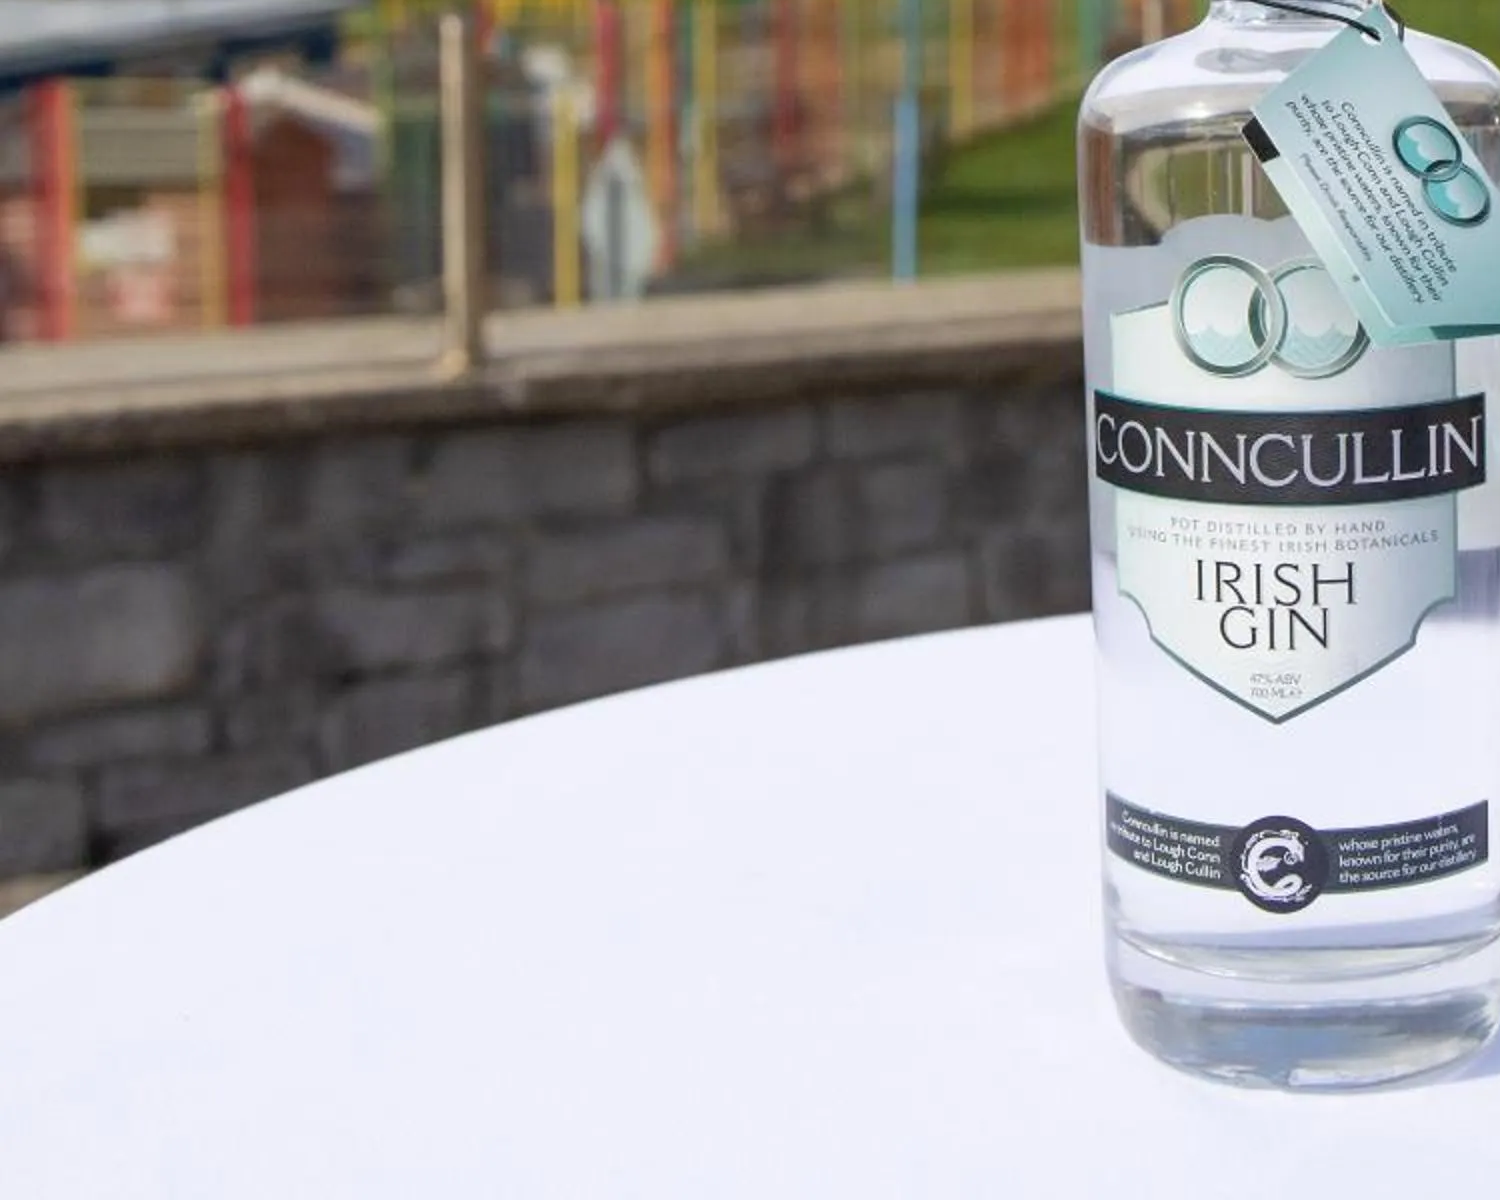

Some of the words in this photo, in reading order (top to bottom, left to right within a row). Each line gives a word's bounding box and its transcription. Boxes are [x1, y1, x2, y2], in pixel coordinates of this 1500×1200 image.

[1300, 94, 1328, 129] whose
[1323, 130, 1356, 171] pristine
[1381, 214, 1411, 255] known
[1408, 254, 1422, 271] for
[1418, 273, 1441, 301] their
[1330, 112, 1360, 151] Lough
[1356, 150, 1382, 185] Conn
[1378, 186, 1401, 209] and
[1394, 208, 1424, 248] Lough
[1420, 248, 1448, 286] Cullin
[1340, 101, 1385, 164] Conncullin
[1390, 176, 1423, 217] named
[1426, 230, 1456, 271] tribute
[1325, 156, 1342, 176] the
[1339, 177, 1367, 213] source
[1363, 214, 1378, 230] for
[1374, 232, 1392, 251] our
[1389, 254, 1424, 303] distillery
[1097, 413, 1482, 487] CONNCULLIN
[1171, 516, 1200, 531] POT
[1206, 519, 1297, 536] DISTILLED
[1304, 522, 1327, 536] BY
[1335, 519, 1386, 535] HAND
[1171, 533, 1202, 549] THE
[1209, 537, 1271, 553] FINEST
[1279, 540, 1327, 553] IRISH
[1335, 529, 1439, 552] BOTANICALS
[1196, 559, 1357, 607] IRISH
[1219, 605, 1329, 650] GIN
[1122, 809, 1168, 838] Conncullin
[1170, 828, 1179, 841] is
[1180, 834, 1220, 847] named
[1339, 837, 1378, 851] whose
[1381, 831, 1422, 851] pristine
[1133, 849, 1150, 863] and
[1151, 852, 1183, 874] Lough
[1185, 861, 1221, 880] Cullin
[1141, 836, 1152, 848] to
[1153, 837, 1185, 860] Lough
[1187, 845, 1221, 865] Conn
[1339, 853, 1382, 868] known
[1384, 851, 1400, 865] for
[1402, 847, 1426, 860] their
[1461, 833, 1476, 846] are
[1339, 869, 1359, 883] the
[1361, 868, 1400, 881] source
[1402, 863, 1417, 877] for
[1419, 861, 1437, 873] our
[1438, 849, 1477, 868] distillery
